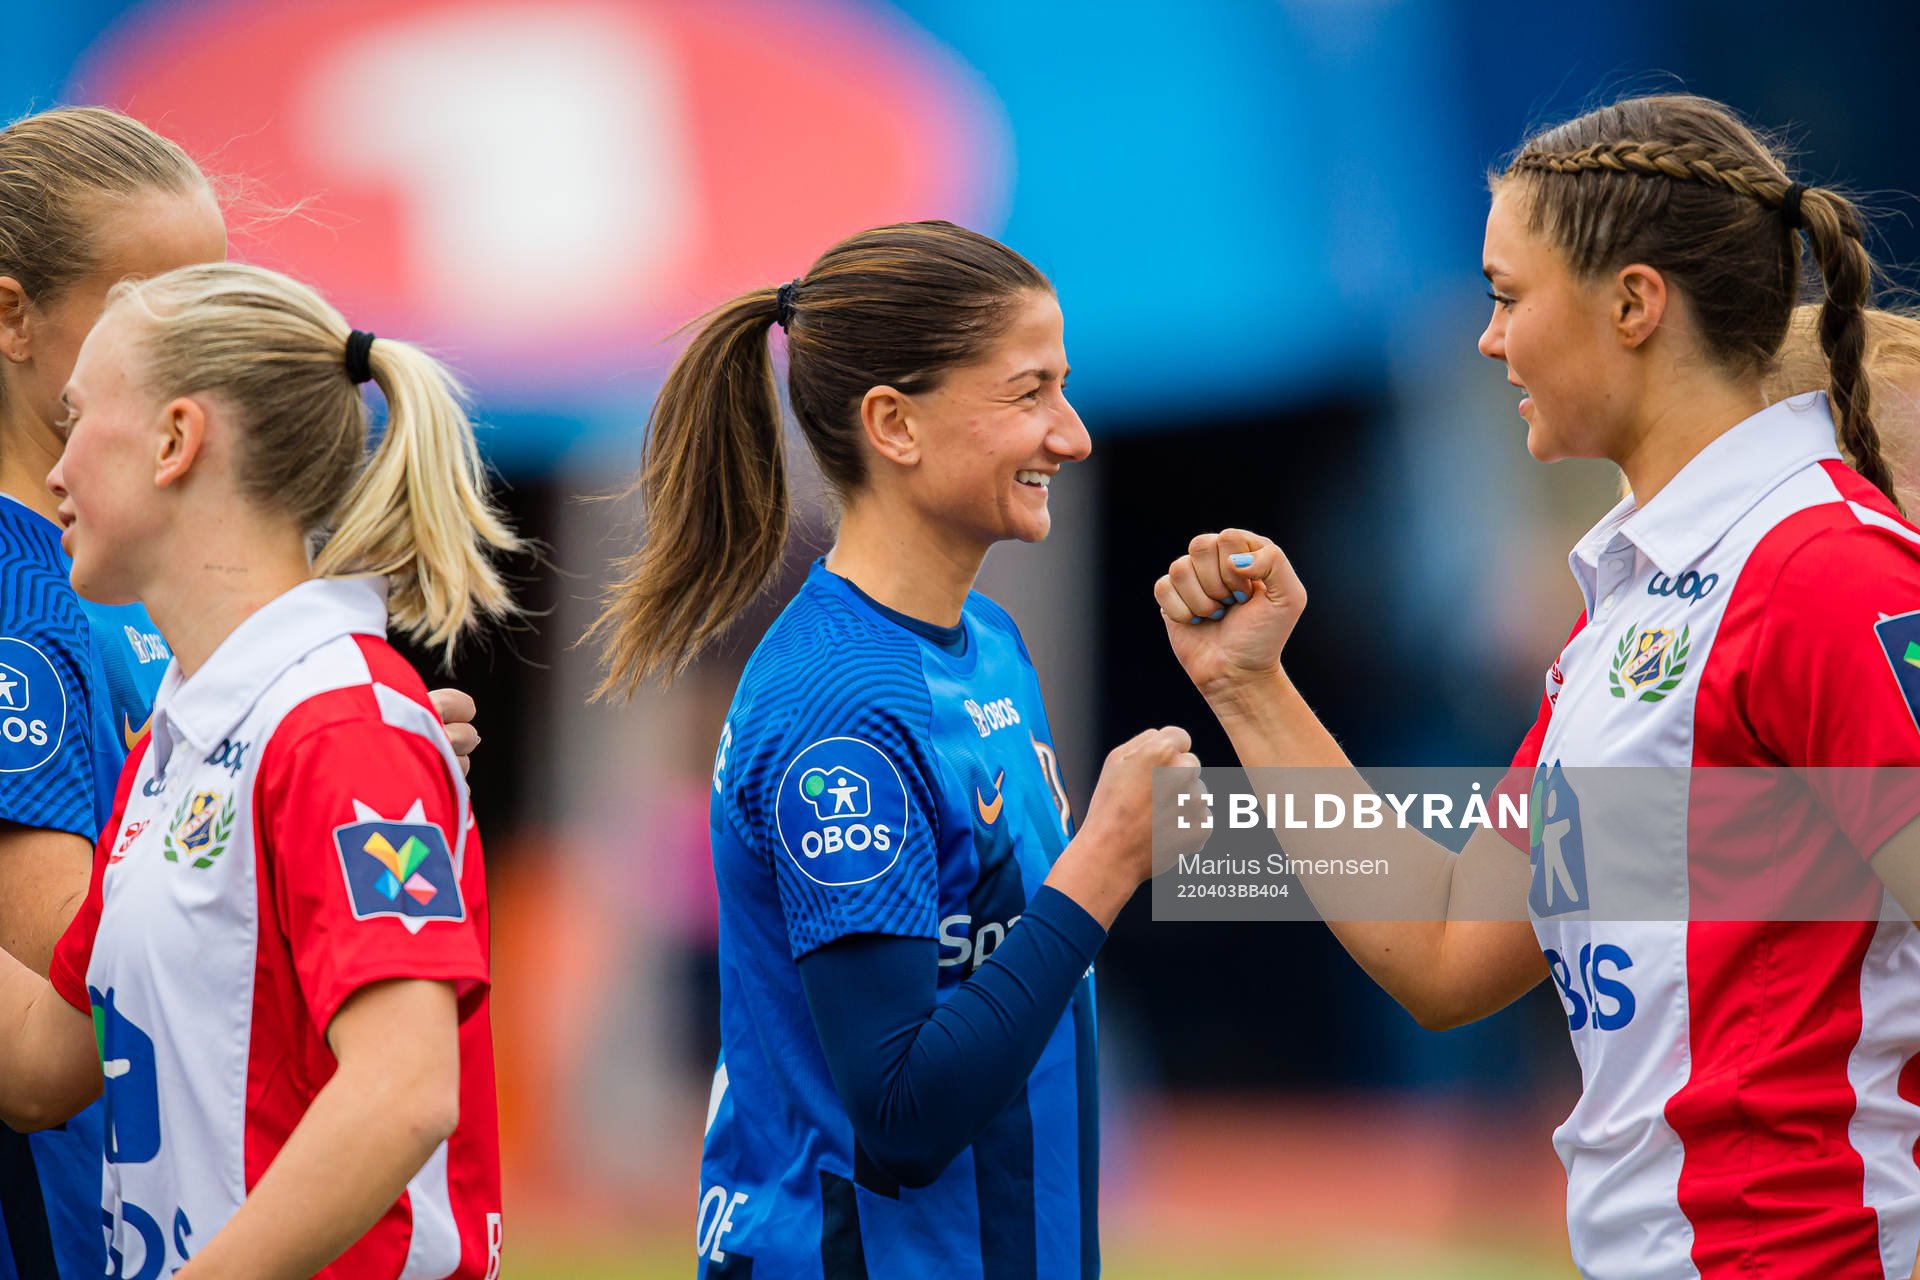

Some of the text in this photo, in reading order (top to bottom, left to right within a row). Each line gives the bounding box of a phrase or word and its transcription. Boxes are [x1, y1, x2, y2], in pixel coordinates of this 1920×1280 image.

[983, 697, 1020, 730] OBOS
[0, 716, 48, 746] OS
[801, 823, 891, 859] OBOS
[938, 914, 1022, 972] Sp
